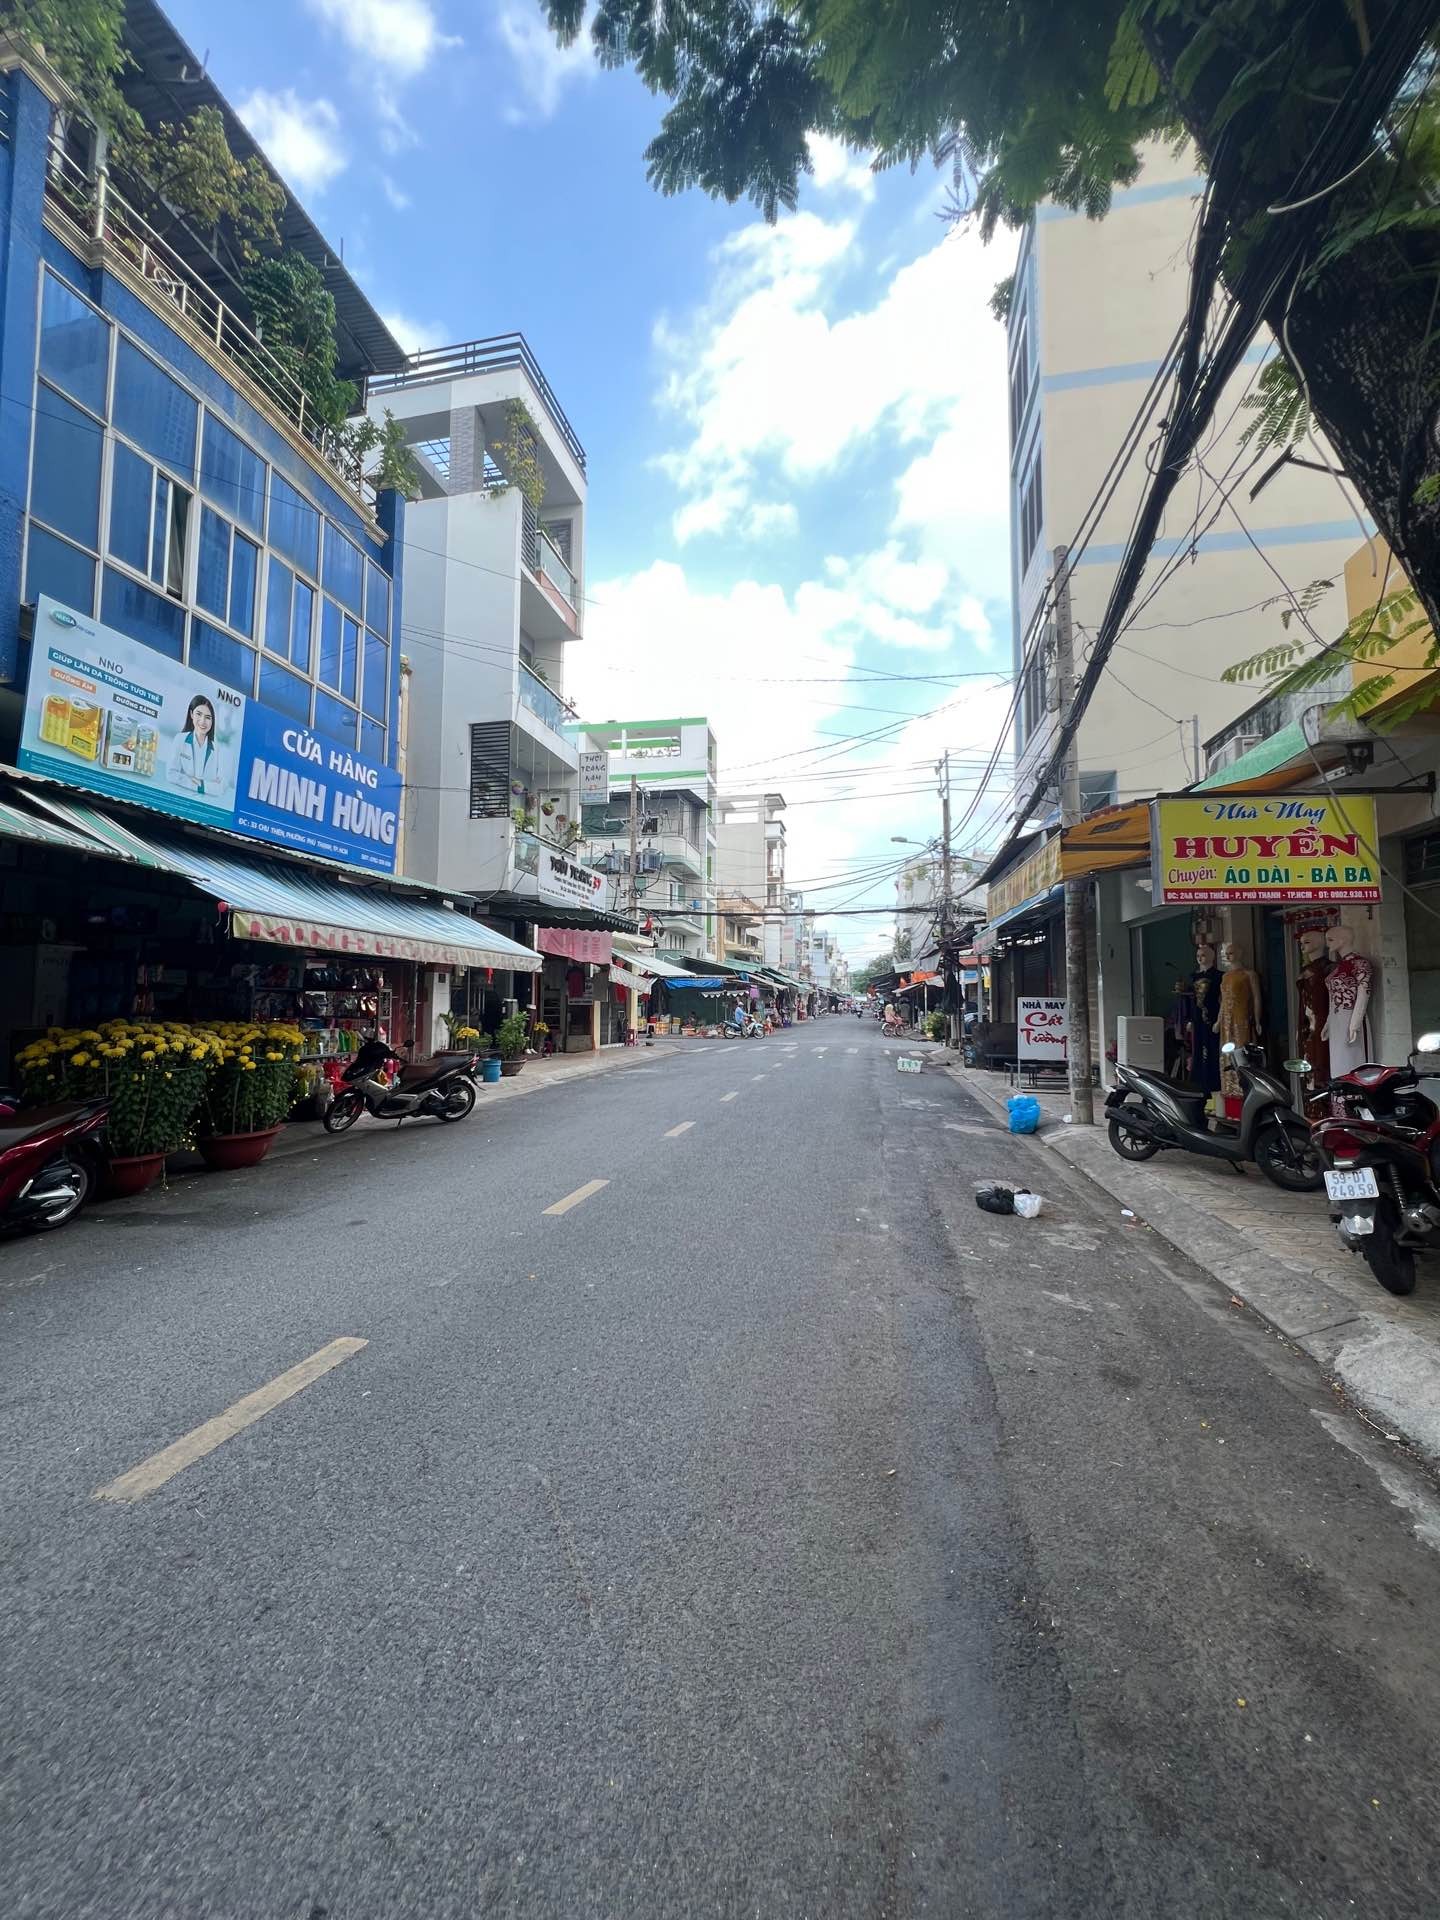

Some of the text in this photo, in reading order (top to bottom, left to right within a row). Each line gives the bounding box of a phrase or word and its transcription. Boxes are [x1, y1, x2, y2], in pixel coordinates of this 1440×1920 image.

[91, 668, 102, 679] DA
[98, 655, 124, 675] NNO
[217, 688, 242, 707] NNO
[282, 730, 378, 789] CỬA HÀNG
[248, 757, 327, 822] MINH
[331, 790, 396, 846] HÙNG
[1203, 801, 1327, 825] Nhà May
[1172, 826, 1360, 860] HUYỀN
[1168, 866, 1217, 885] Chuyên:
[1224, 865, 1250, 884] ÁO
[1257, 867, 1290, 884] DÀI
[1311, 866, 1339, 883] BÀ
[1344, 867, 1372, 883] BA
[249, 920, 365, 952] MINH
[1022, 1000, 1066, 1010] NHÀ MAY
[1024, 1011, 1064, 1027] Cát
